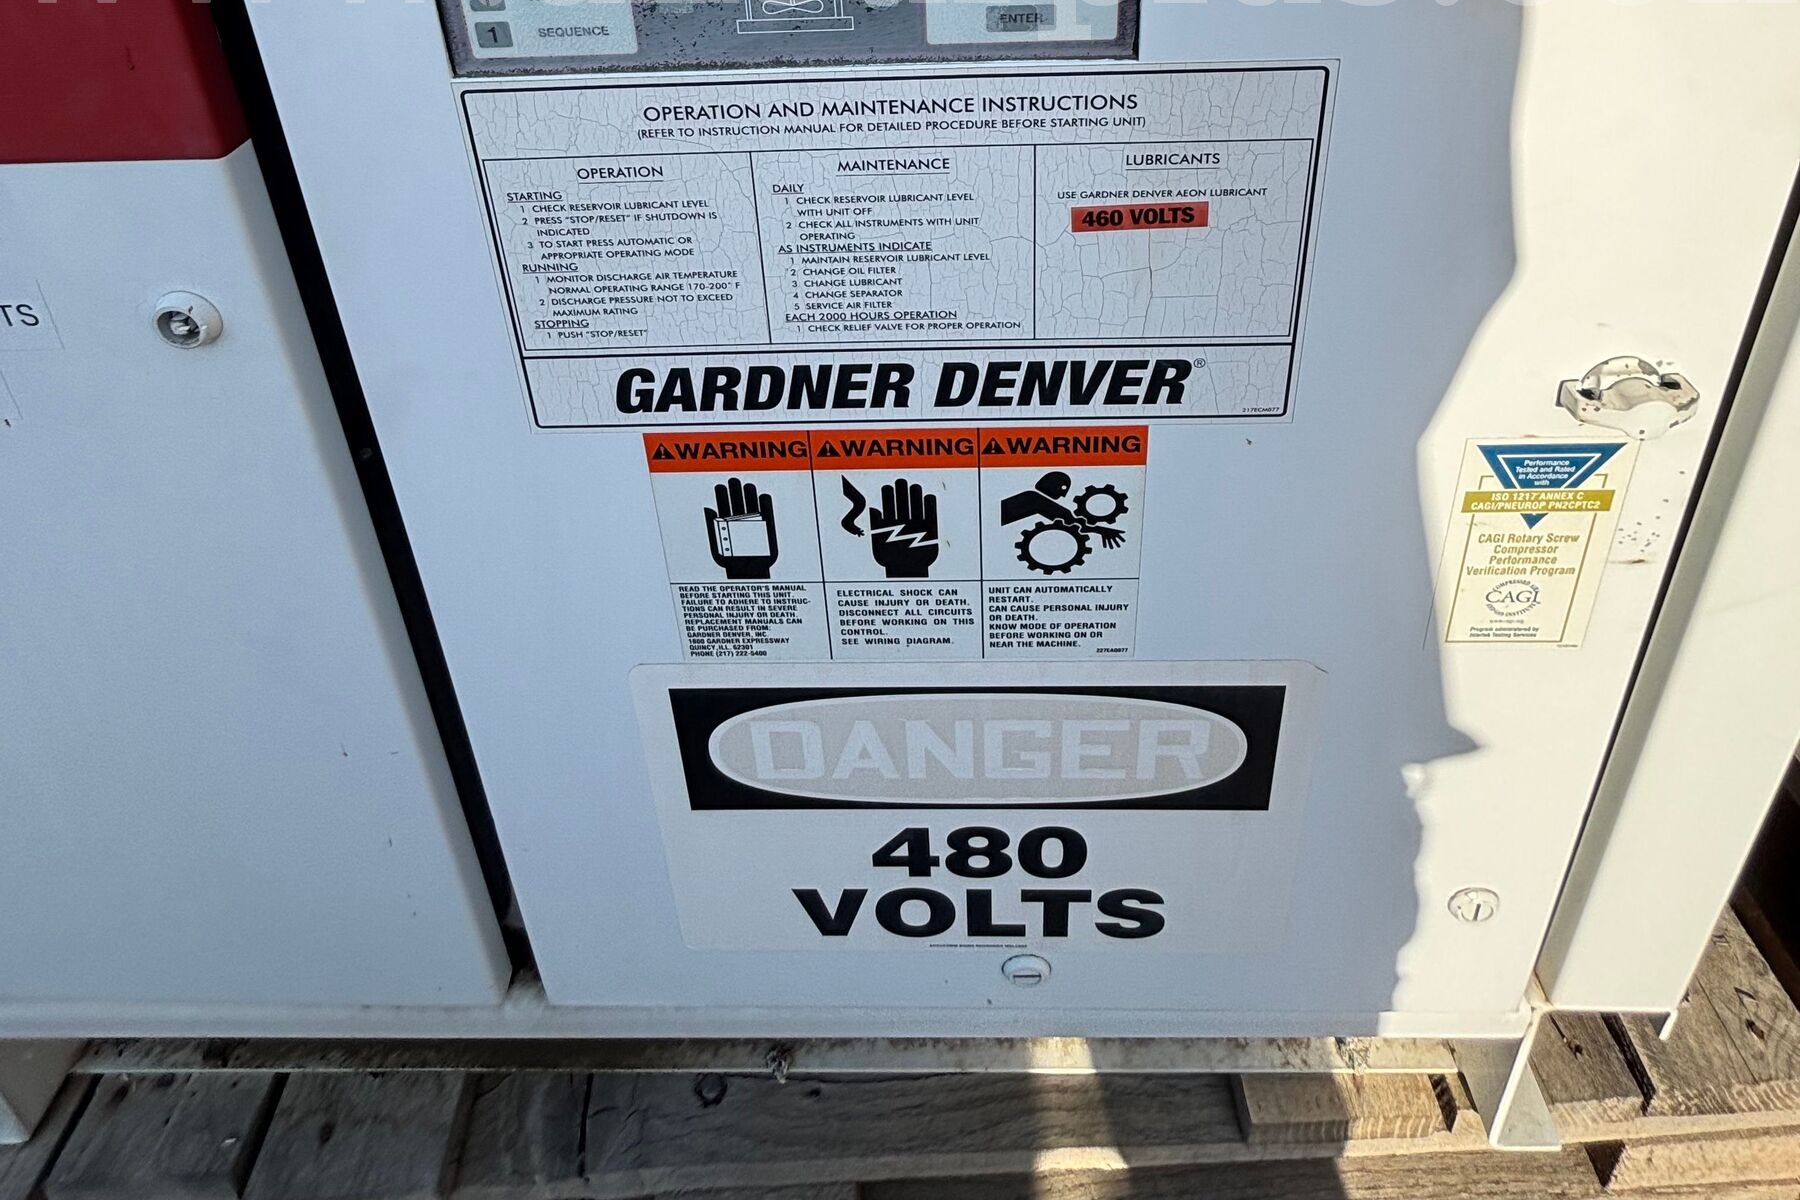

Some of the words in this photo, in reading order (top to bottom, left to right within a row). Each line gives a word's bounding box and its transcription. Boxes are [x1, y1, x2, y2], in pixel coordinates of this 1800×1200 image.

[1000, 13, 1046, 23] ENTER
[539, 26, 609, 37] SEQUENCE
[643, 103, 760, 122] OPERATION
[768, 102, 814, 118] AND
[822, 97, 975, 117] MAINTENANCE
[983, 94, 1137, 112] INSTRUCTIONS
[638, 128, 675, 140] (REFER
[680, 128, 694, 137] TO
[699, 125, 779, 136] INSTRUCTION
[784, 124, 836, 134] MANUAL
[839, 123, 863, 133] FOR
[867, 121, 921, 132] DETAILED
[926, 120, 997, 130] PROCEDURE
[1002, 119, 1047, 129] BEFORE
[1050, 118, 1108, 127] STARTING
[1113, 116, 1145, 128] UNIT)
[838, 158, 949, 172] MAINTENANCE
[1126, 153, 1220, 166] LUBRICANTS
[578, 166, 663, 180] OPERATION
[772, 184, 804, 193] DAILY
[1058, 191, 1076, 199] USE
[1080, 190, 1129, 199] GARDNER
[1133, 189, 1172, 198] DENVER
[1176, 189, 1206, 197] AEON
[1210, 188, 1267, 197] LUBRICANT
[507, 191, 562, 201] STARTING
[532, 204, 567, 213] CHECK
[570, 203, 621, 212] RESERVOIR
[625, 201, 678, 210] LUBRICANT
[682, 200, 709, 209] LEVEL
[797, 208, 823, 217] WITH
[826, 208, 850, 216] UNIT
[853, 207, 872, 215] OFF
[1082, 209, 1124, 227] 460
[1130, 207, 1195, 225] VOLTS
[537, 228, 590, 236] INDICATED
[800, 232, 855, 241] OPERATING
[779, 245, 792, 253] AS
[797, 243, 875, 253] INSTRUMENTS
[879, 242, 932, 251] INDICATE
[522, 263, 578, 273] RUNNING
[803, 267, 845, 276] CHANGE
[849, 267, 865, 275] OIL
[868, 266, 896, 275] FILTER
[547, 275, 594, 283] MONITOR
[597, 273, 651, 282] DISCHARGE
[655, 272, 670, 280] AIR
[673, 270, 737, 279] TEMPERATURE
[553, 309, 600, 317] MAXIMUM
[603, 308, 638, 316] RATING
[786, 313, 815, 322] EACH
[819, 312, 846, 321] 2000
[851, 311, 890, 320] HOURS
[893, 311, 957, 320] OPERATION
[535, 320, 589, 329] STOPPING
[616, 363, 913, 414] GARDNER
[675, 440, 808, 460] WARNING
[842, 438, 974, 457] WARNING
[1006, 435, 1141, 455] WARNING
[1491, 493, 1509, 501] ISO
[1512, 492, 1535, 500] 1217
[1539, 492, 1574, 500] ANNEX
[1471, 501, 1546, 510] CAGI/PNEUROP
[1549, 501, 1600, 509] PN2CPTC2
[1478, 534, 1504, 543] CAGI
[1508, 533, 1542, 545] Rotary
[1546, 533, 1580, 543] Screw
[1494, 545, 1558, 555] Compressor
[1489, 555, 1557, 565] Performance
[1466, 566, 1526, 576] Verification
[1530, 566, 1575, 577] Program
[939, 588, 958, 596] CAN
[1013, 586, 1032, 594] CAN
[1035, 585, 1112, 593] AUTOMATICALLY
[1485, 590, 1539, 603] CAGI
[875, 599, 909, 607] INJURY
[1044, 604, 1092, 612] PERSONAL
[1095, 603, 1128, 611] INJURY
[748, 719, 1209, 782] DANGER
[872, 827, 1087, 878] 480
[792, 888, 1164, 938] VOLTS
